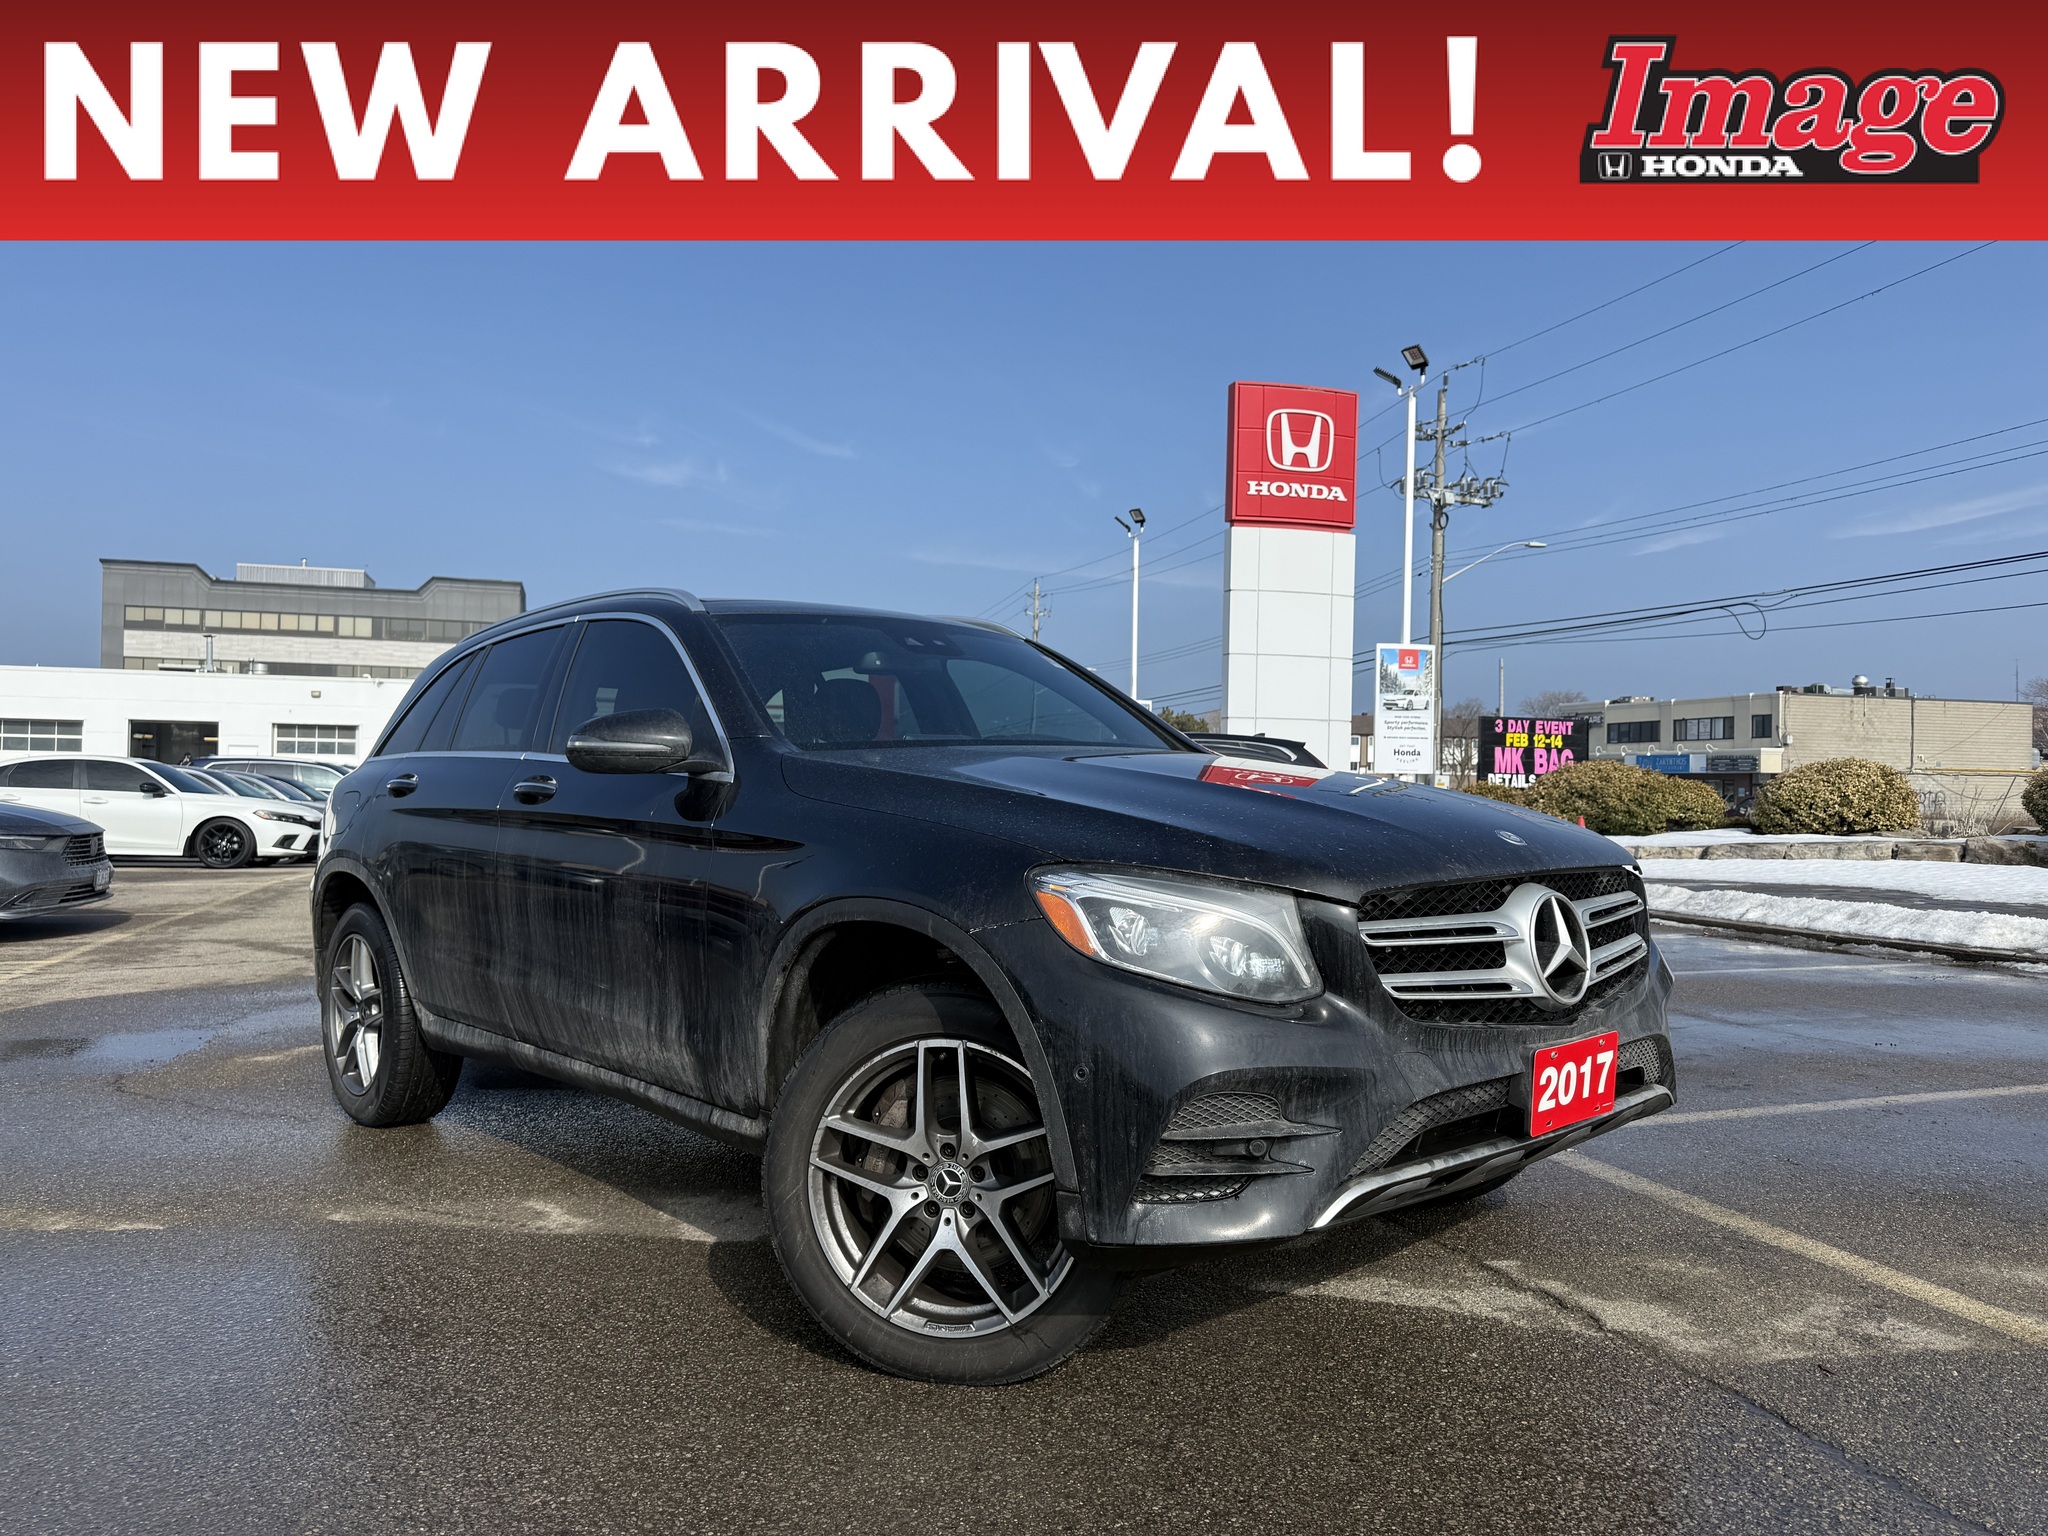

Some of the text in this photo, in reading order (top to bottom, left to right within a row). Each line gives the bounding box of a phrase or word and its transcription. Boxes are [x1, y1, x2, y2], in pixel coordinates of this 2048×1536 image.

[1247, 480, 1348, 502] HONDA
[1494, 719, 1574, 735] 3 DAY EVENT
[1506, 733, 1563, 748] FEB 12-14
[1393, 748, 1421, 756] Honda
[1494, 747, 1525, 774] MK
[1488, 773, 1537, 788] DETAILS
[1537, 1050, 1614, 1113] 2017
